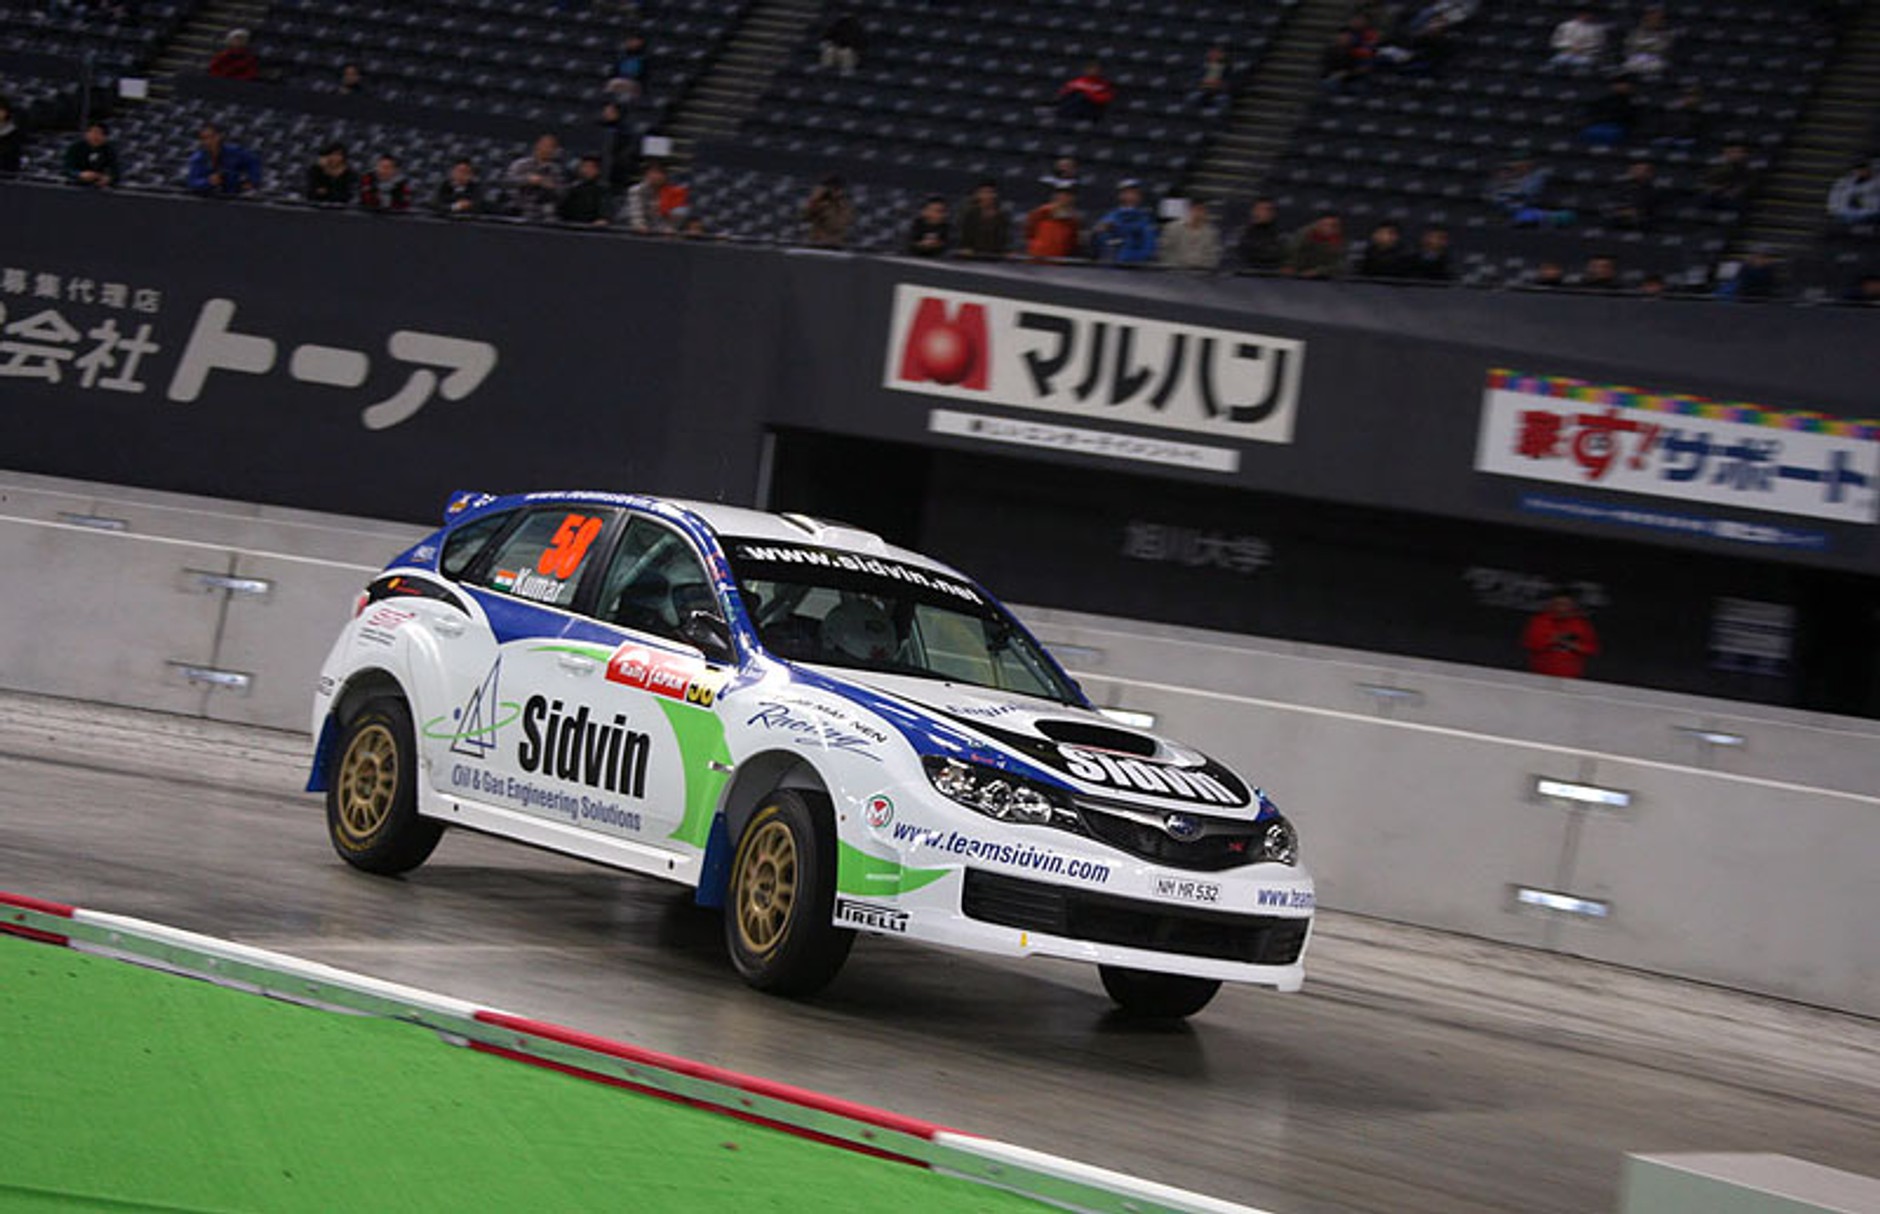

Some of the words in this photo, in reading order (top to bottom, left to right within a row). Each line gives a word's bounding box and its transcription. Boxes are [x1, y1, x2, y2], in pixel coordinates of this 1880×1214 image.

[1015, 311, 1292, 424] マルハン
[509, 566, 565, 603] Kumar
[518, 694, 651, 799] Sidvin
[482, 771, 505, 797] Gas
[506, 777, 580, 821] Engineering
[580, 796, 642, 832] Solutions
